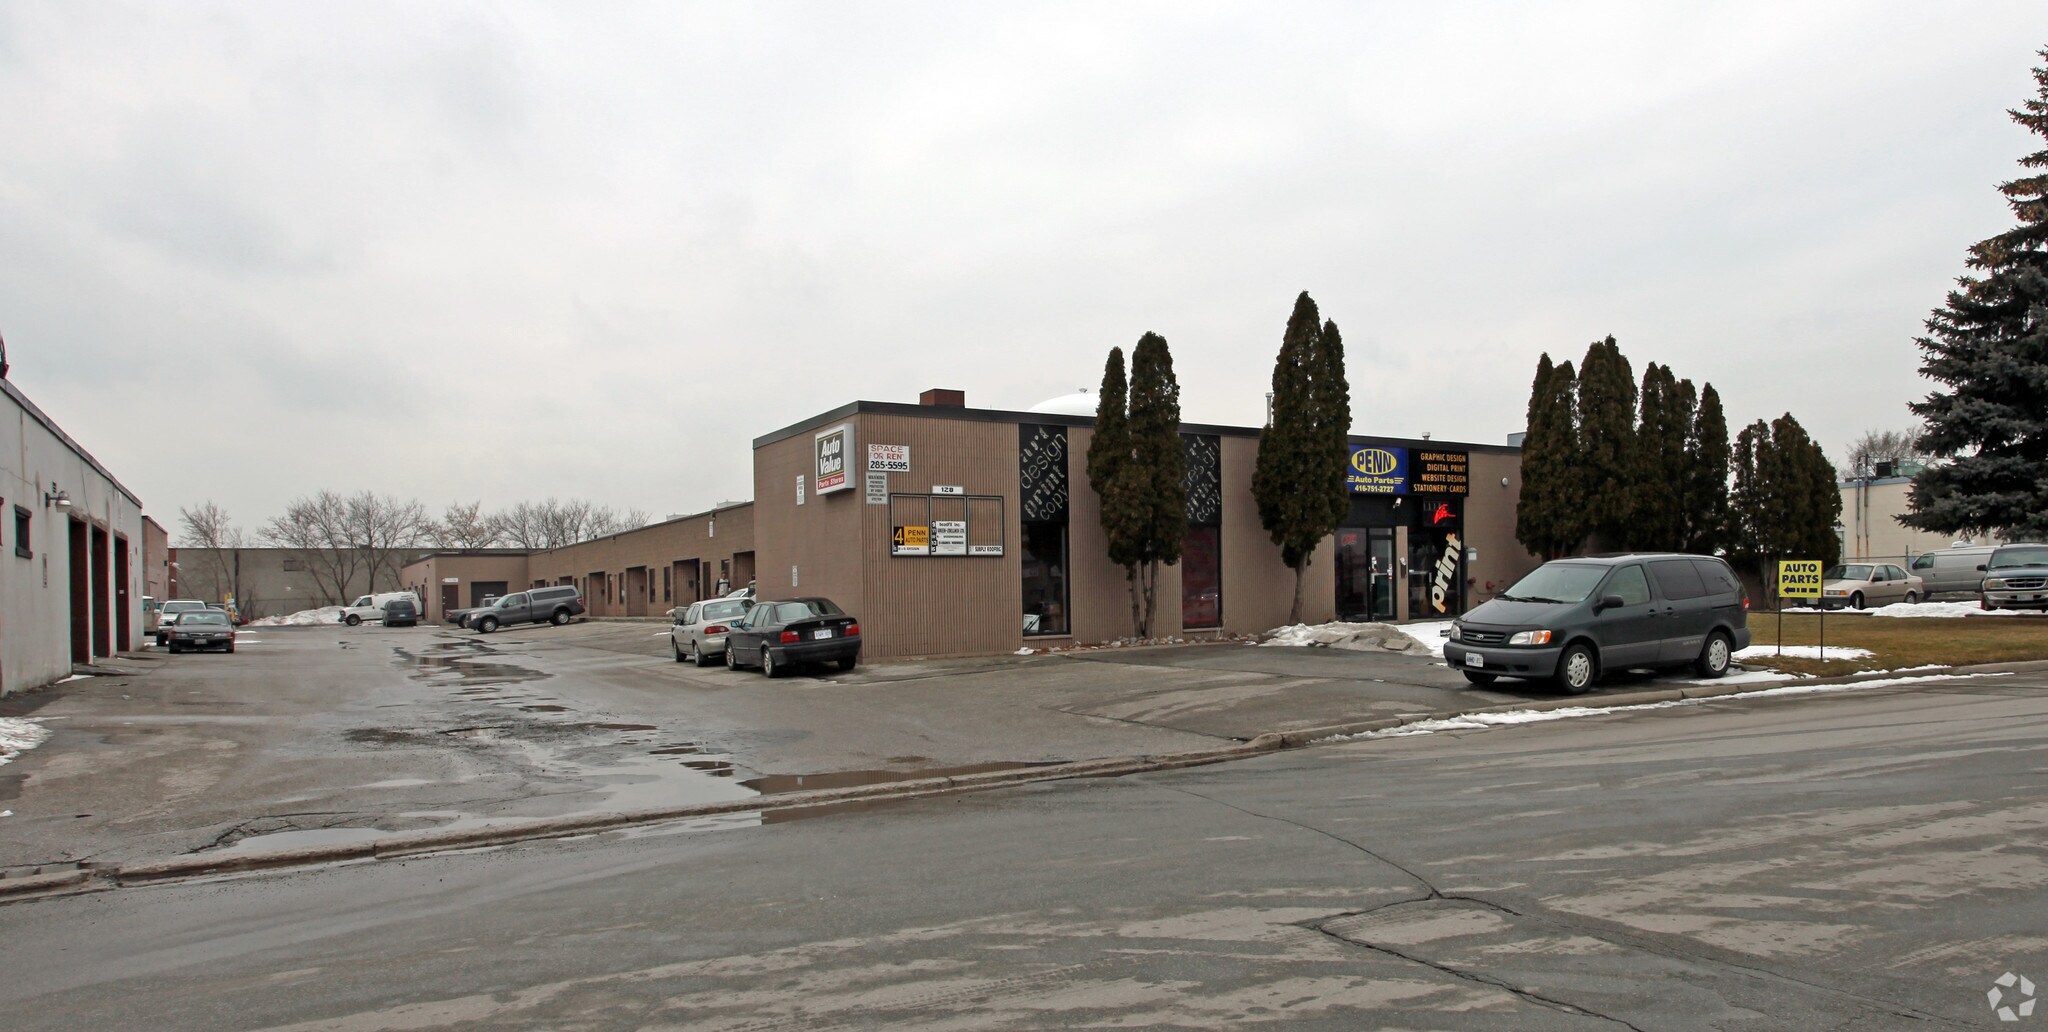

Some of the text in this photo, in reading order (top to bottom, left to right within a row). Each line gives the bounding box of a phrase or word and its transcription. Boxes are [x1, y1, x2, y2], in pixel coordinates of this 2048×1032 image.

[821, 437, 840, 458] Auto
[870, 445, 904, 453] SPACE
[1021, 433, 1066, 489] design
[1356, 451, 1392, 474] PENN
[1420, 453, 1466, 462] GRAPHIC DESIGN
[820, 456, 842, 475] Value
[1427, 464, 1449, 472] DIGITAL
[818, 476, 844, 488] Parts Stores
[1354, 475, 1395, 485] Auto Parts
[1422, 474, 1466, 483] WEBSITE DESIGN
[1024, 465, 1065, 518] print
[1354, 485, 1395, 493] 416-751-2727
[1040, 484, 1068, 520] copy
[894, 528, 904, 545] 4
[1432, 533, 1462, 613] print
[1784, 563, 1817, 573] AUTO
[1782, 574, 1819, 584] PARTS
